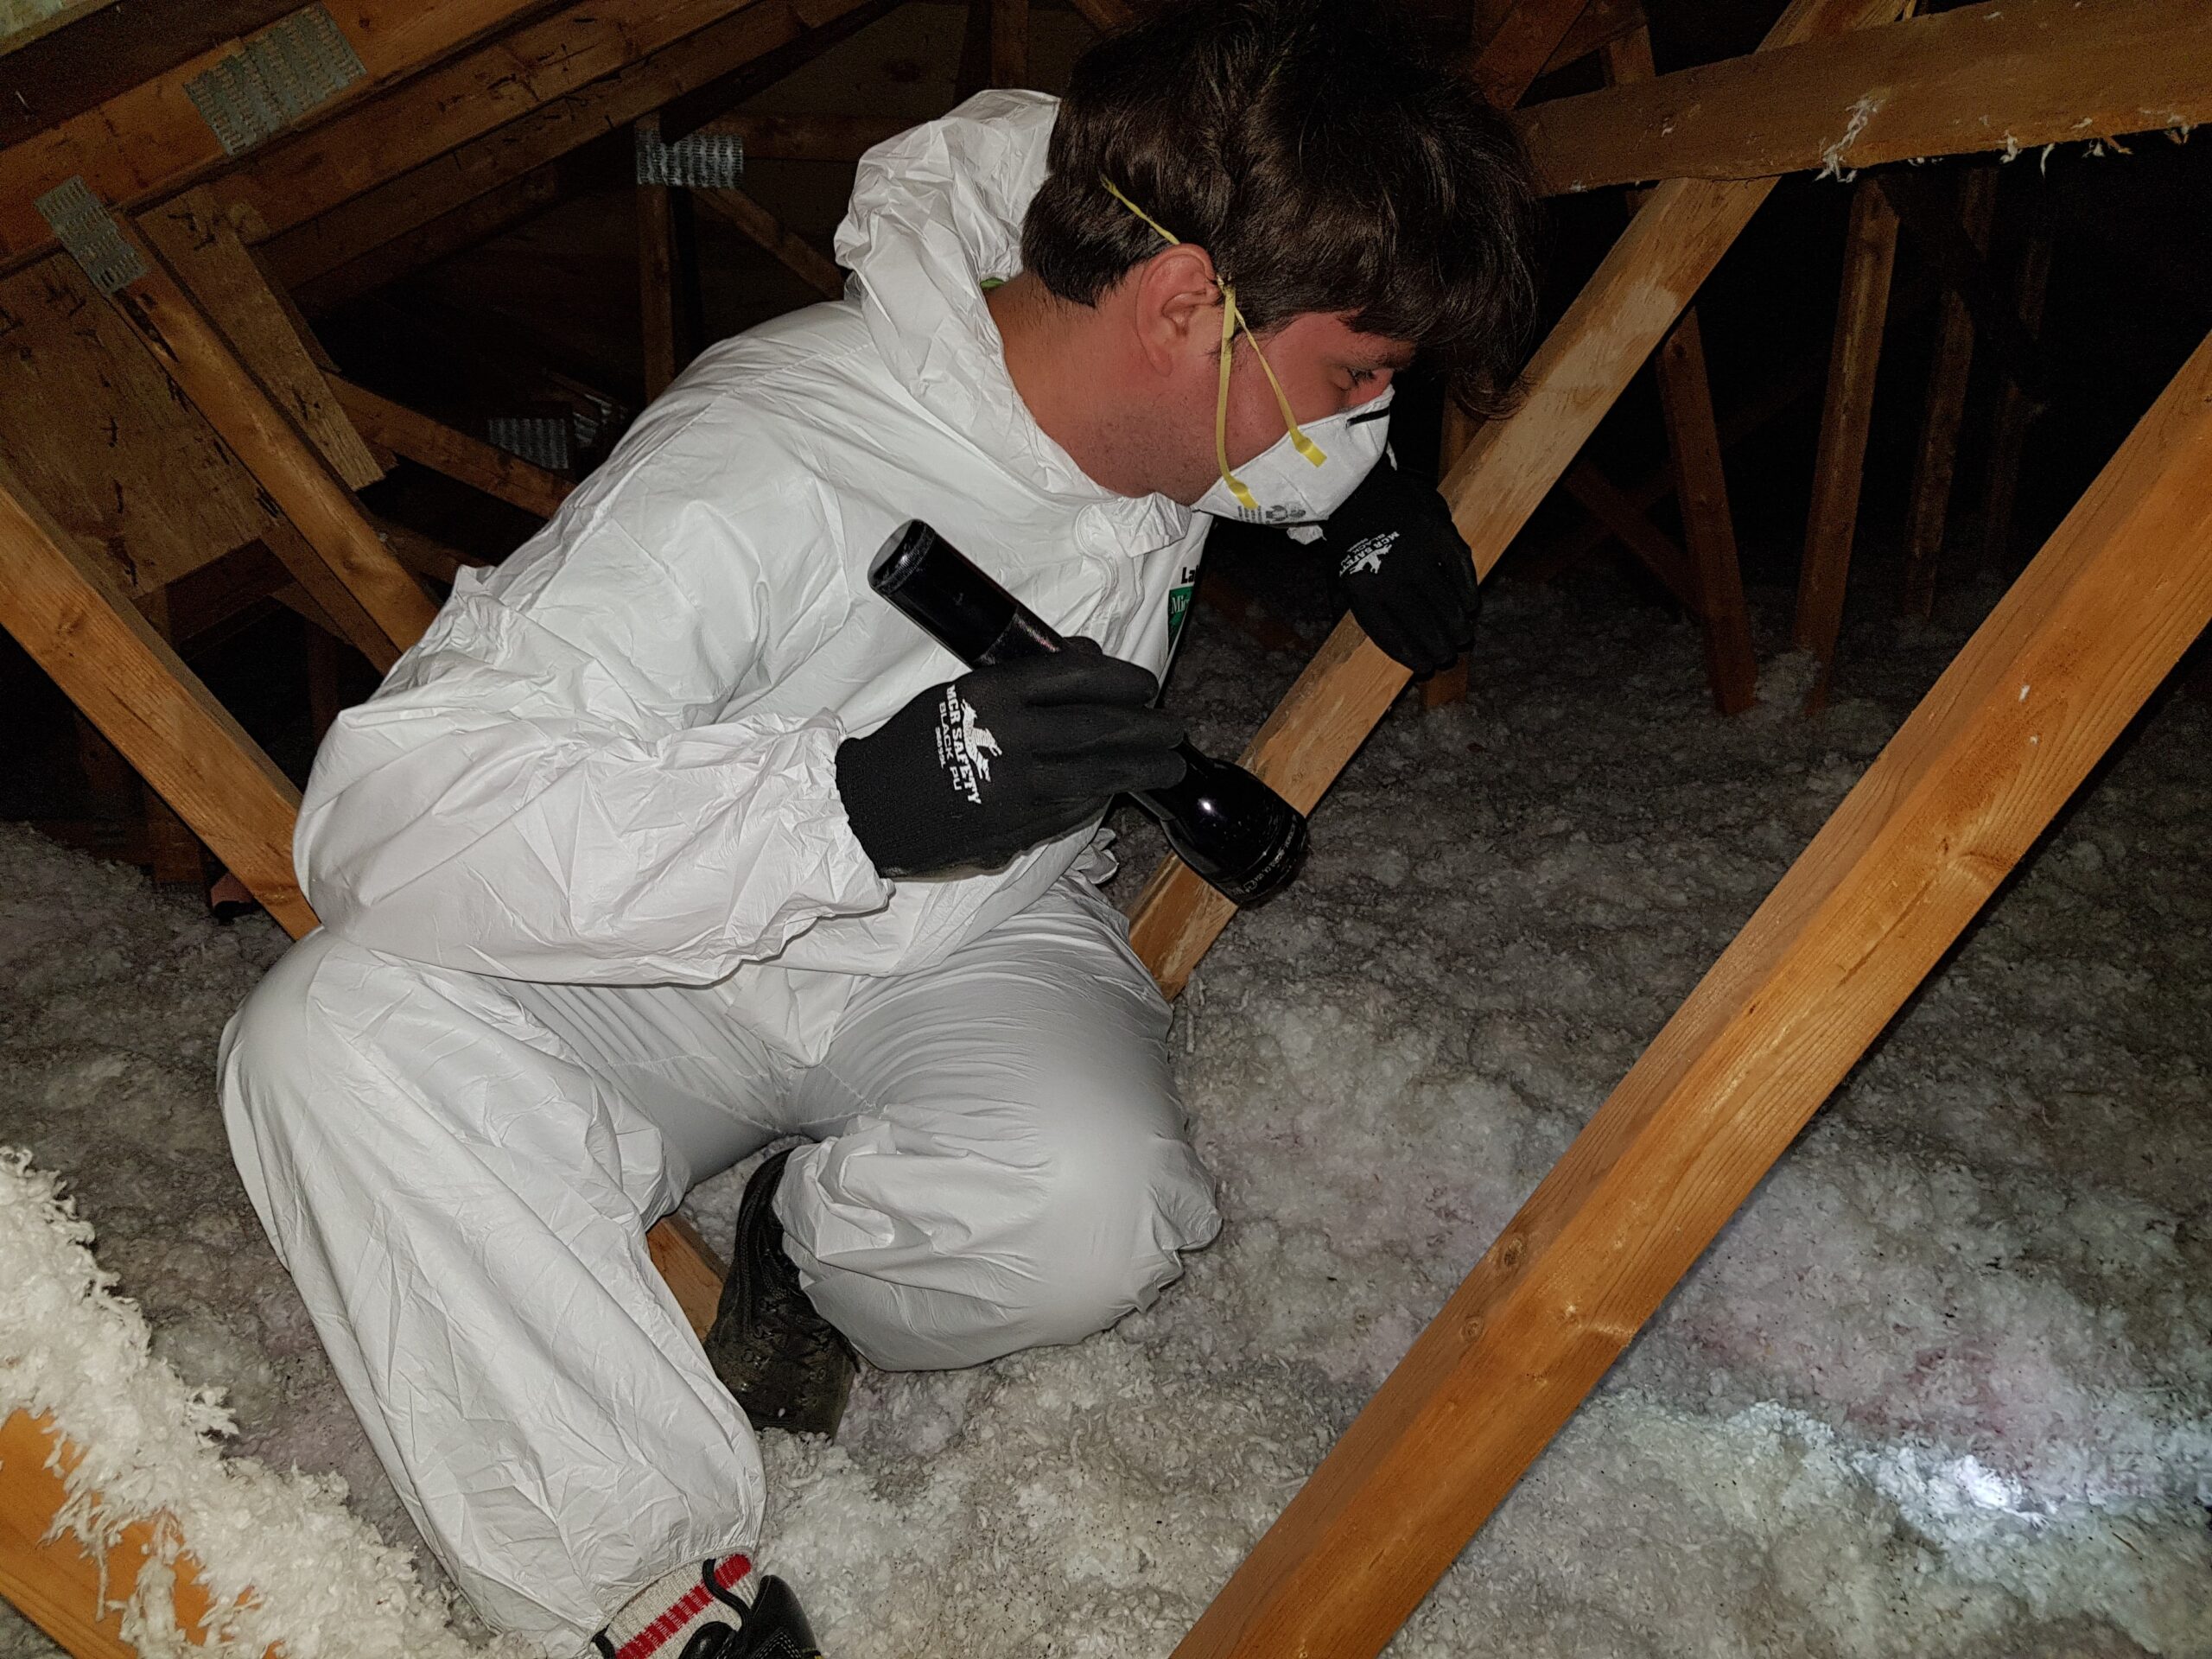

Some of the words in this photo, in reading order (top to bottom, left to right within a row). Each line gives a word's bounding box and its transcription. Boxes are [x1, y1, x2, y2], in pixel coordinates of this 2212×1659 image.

[1373, 531, 1400, 549] MCR
[946, 684, 961, 724] MCR
[939, 701, 954, 760] BLACK
[950, 766, 963, 791] PU
[952, 727, 982, 804] SAFETY
